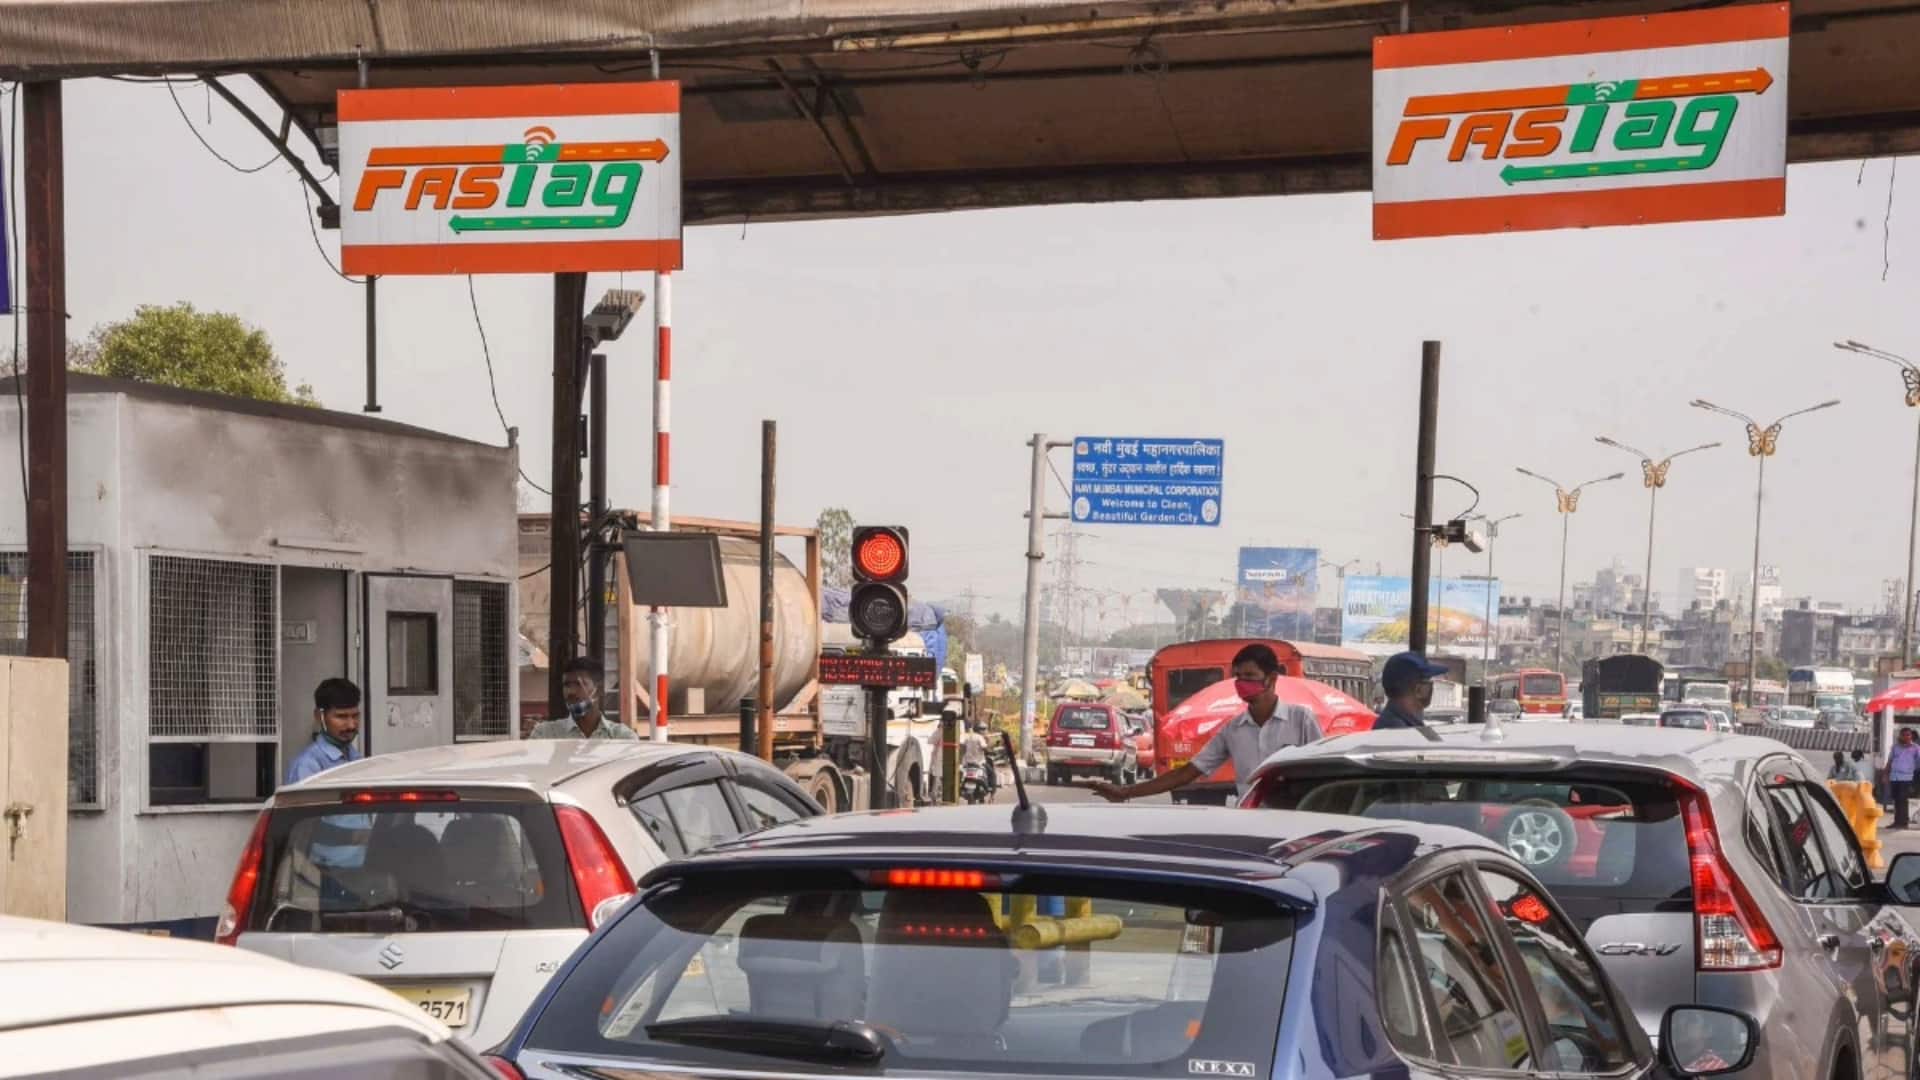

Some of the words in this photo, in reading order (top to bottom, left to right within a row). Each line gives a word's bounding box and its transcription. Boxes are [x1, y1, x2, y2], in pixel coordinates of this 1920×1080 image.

[1386, 82, 1738, 183] FASTag
[353, 142, 644, 231] FASTag
[1093, 439, 1112, 456] नवी
[1116, 440, 1139, 458] मुंबई
[1142, 441, 1221, 458] महानगरपालिका
[1074, 483, 1092, 493] NAVI
[1093, 483, 1122, 494] MUMBAI
[1124, 484, 1164, 496] MUNICIPAL
[1164, 485, 1219, 497] CORPORATION
[1101, 498, 1145, 508] Welcome
[1147, 499, 1158, 509] to
[1092, 511, 1137, 521] Beautiful
[1140, 512, 1175, 522] Garden
[1178, 513, 1198, 524] City
[1597, 942, 1682, 956] CR-V
[1194, 1061, 1251, 1075] NEXA
